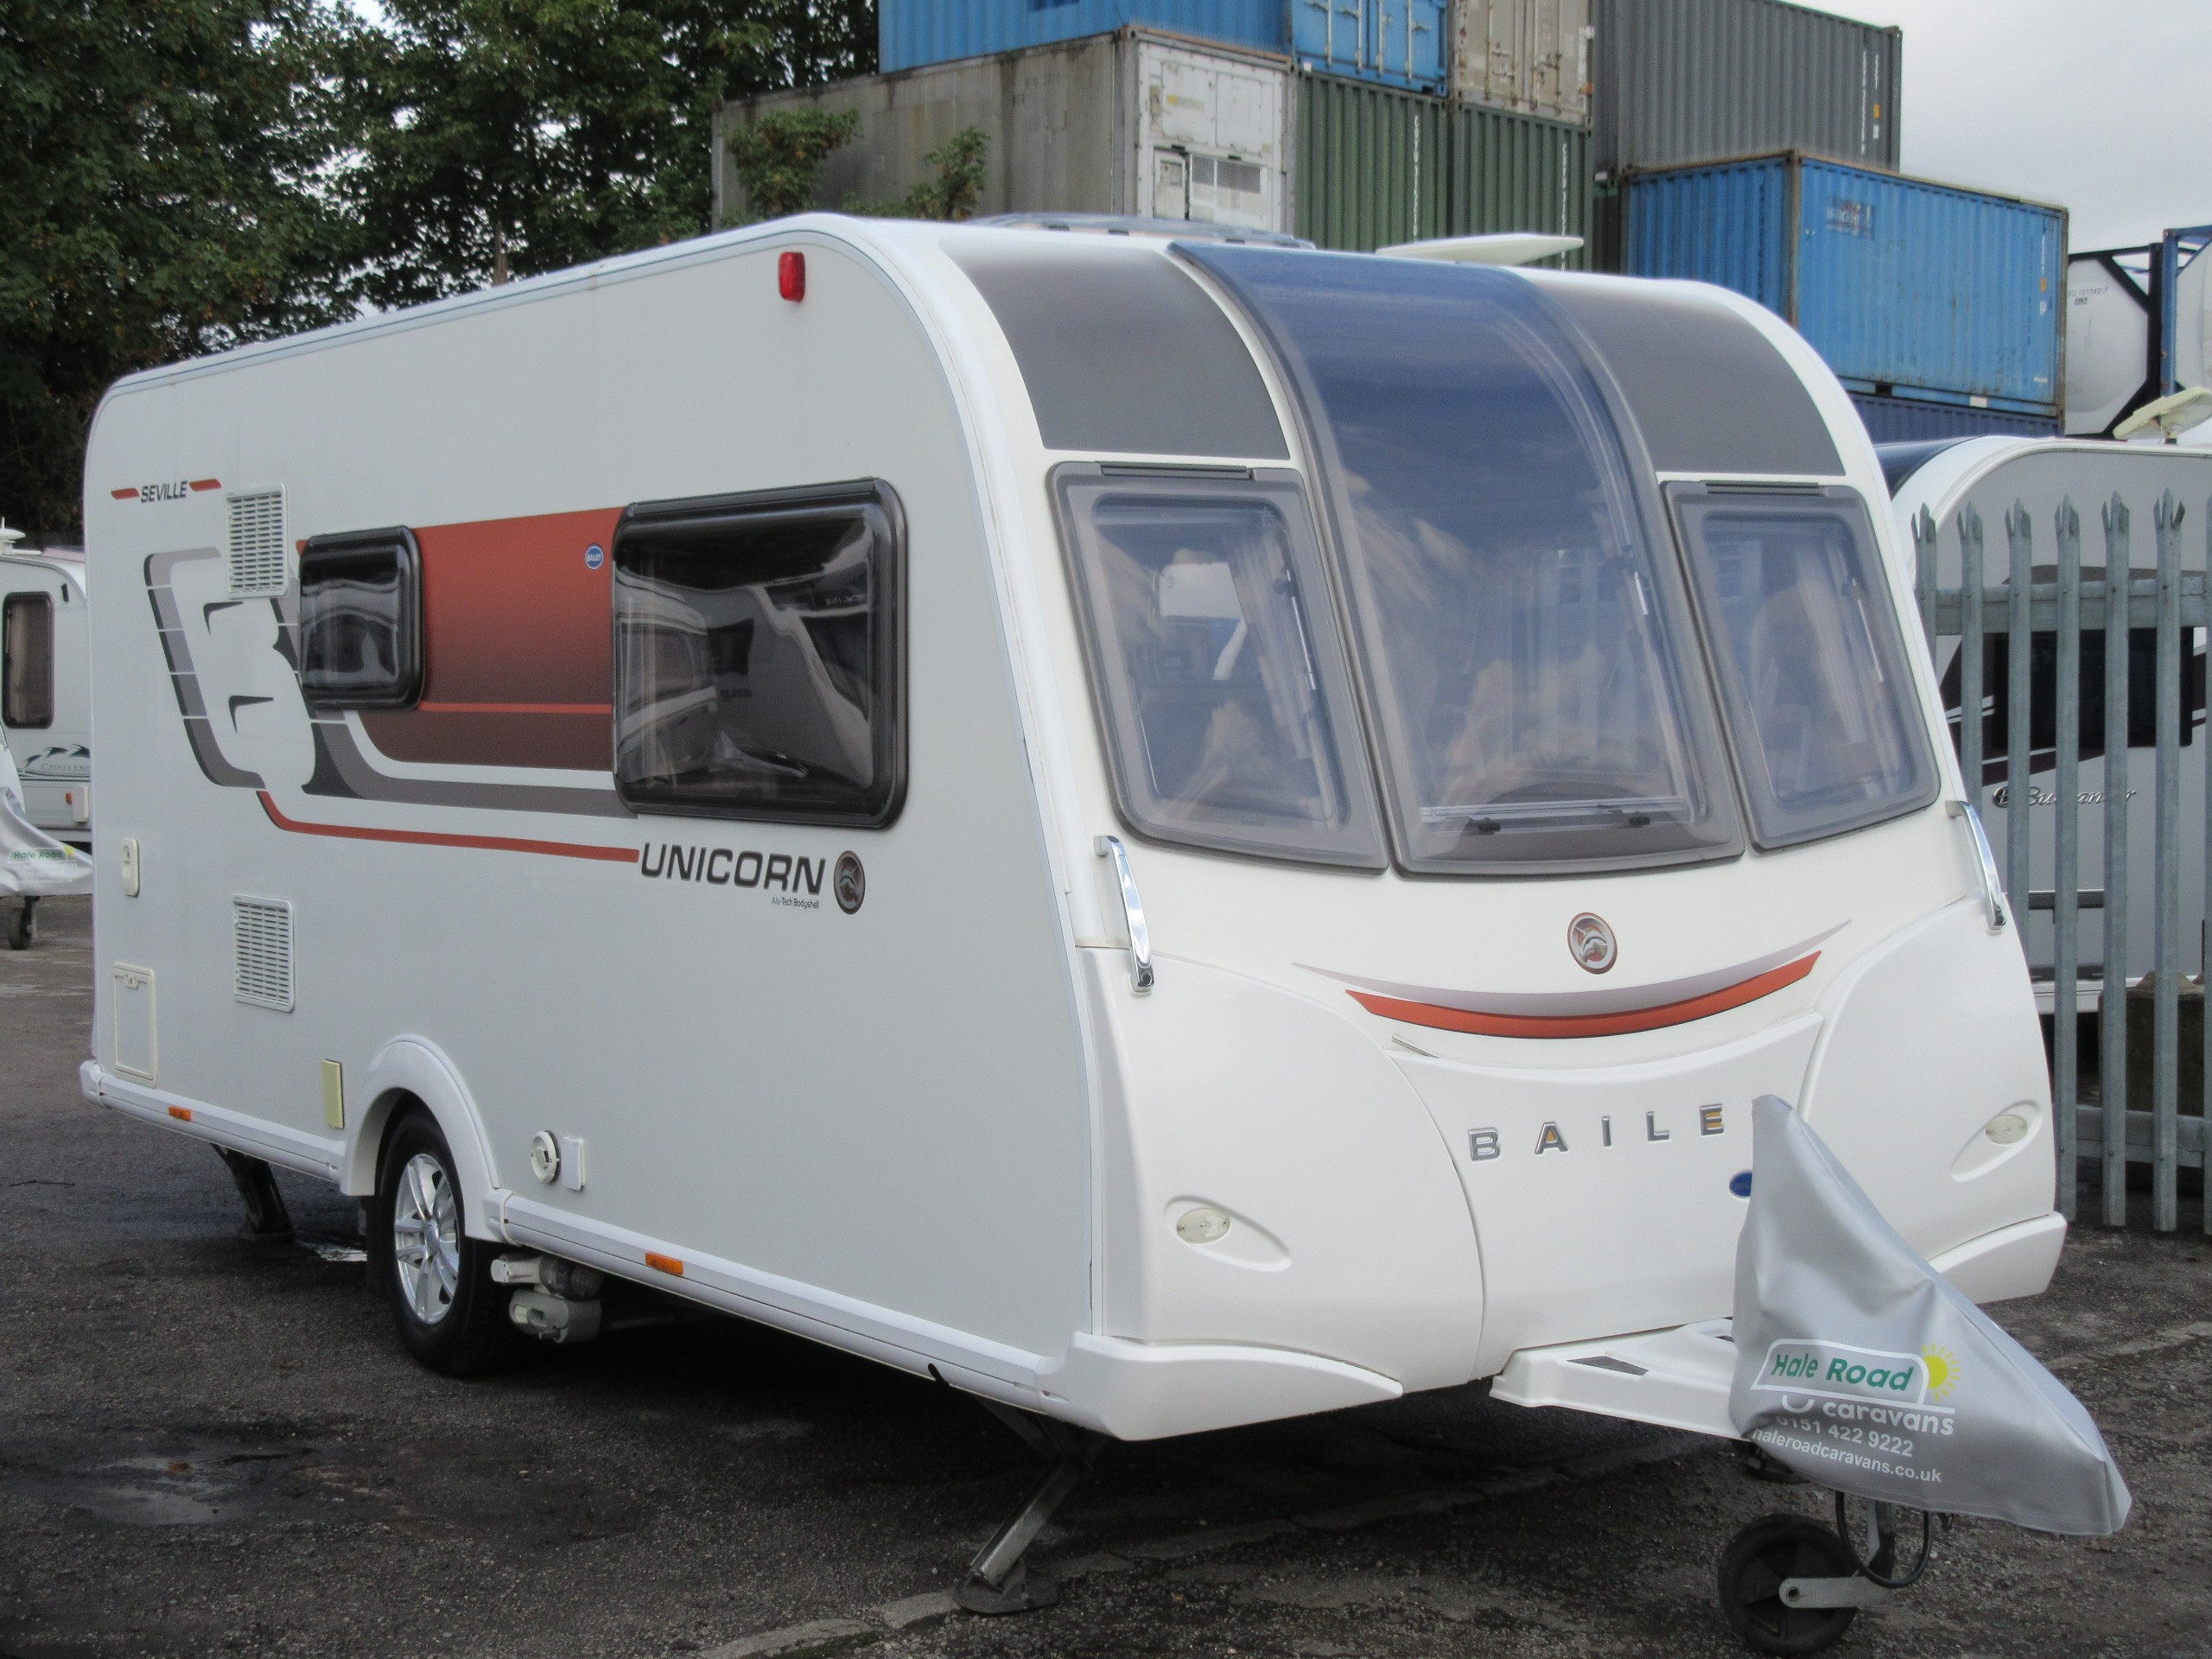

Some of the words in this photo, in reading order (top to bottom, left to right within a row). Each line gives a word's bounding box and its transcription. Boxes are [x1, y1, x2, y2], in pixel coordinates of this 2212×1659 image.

[140, 480, 188, 503] SEVILLE
[641, 842, 826, 895] UNICORN
[793, 898, 820, 910] Bodyshell
[1770, 1352, 1819, 1379] Hale
[1825, 1357, 1915, 1391] Road
[1822, 1402, 1955, 1435] caravans
[1827, 1424, 1863, 1444] 422
[1867, 1431, 1914, 1458] 9222
